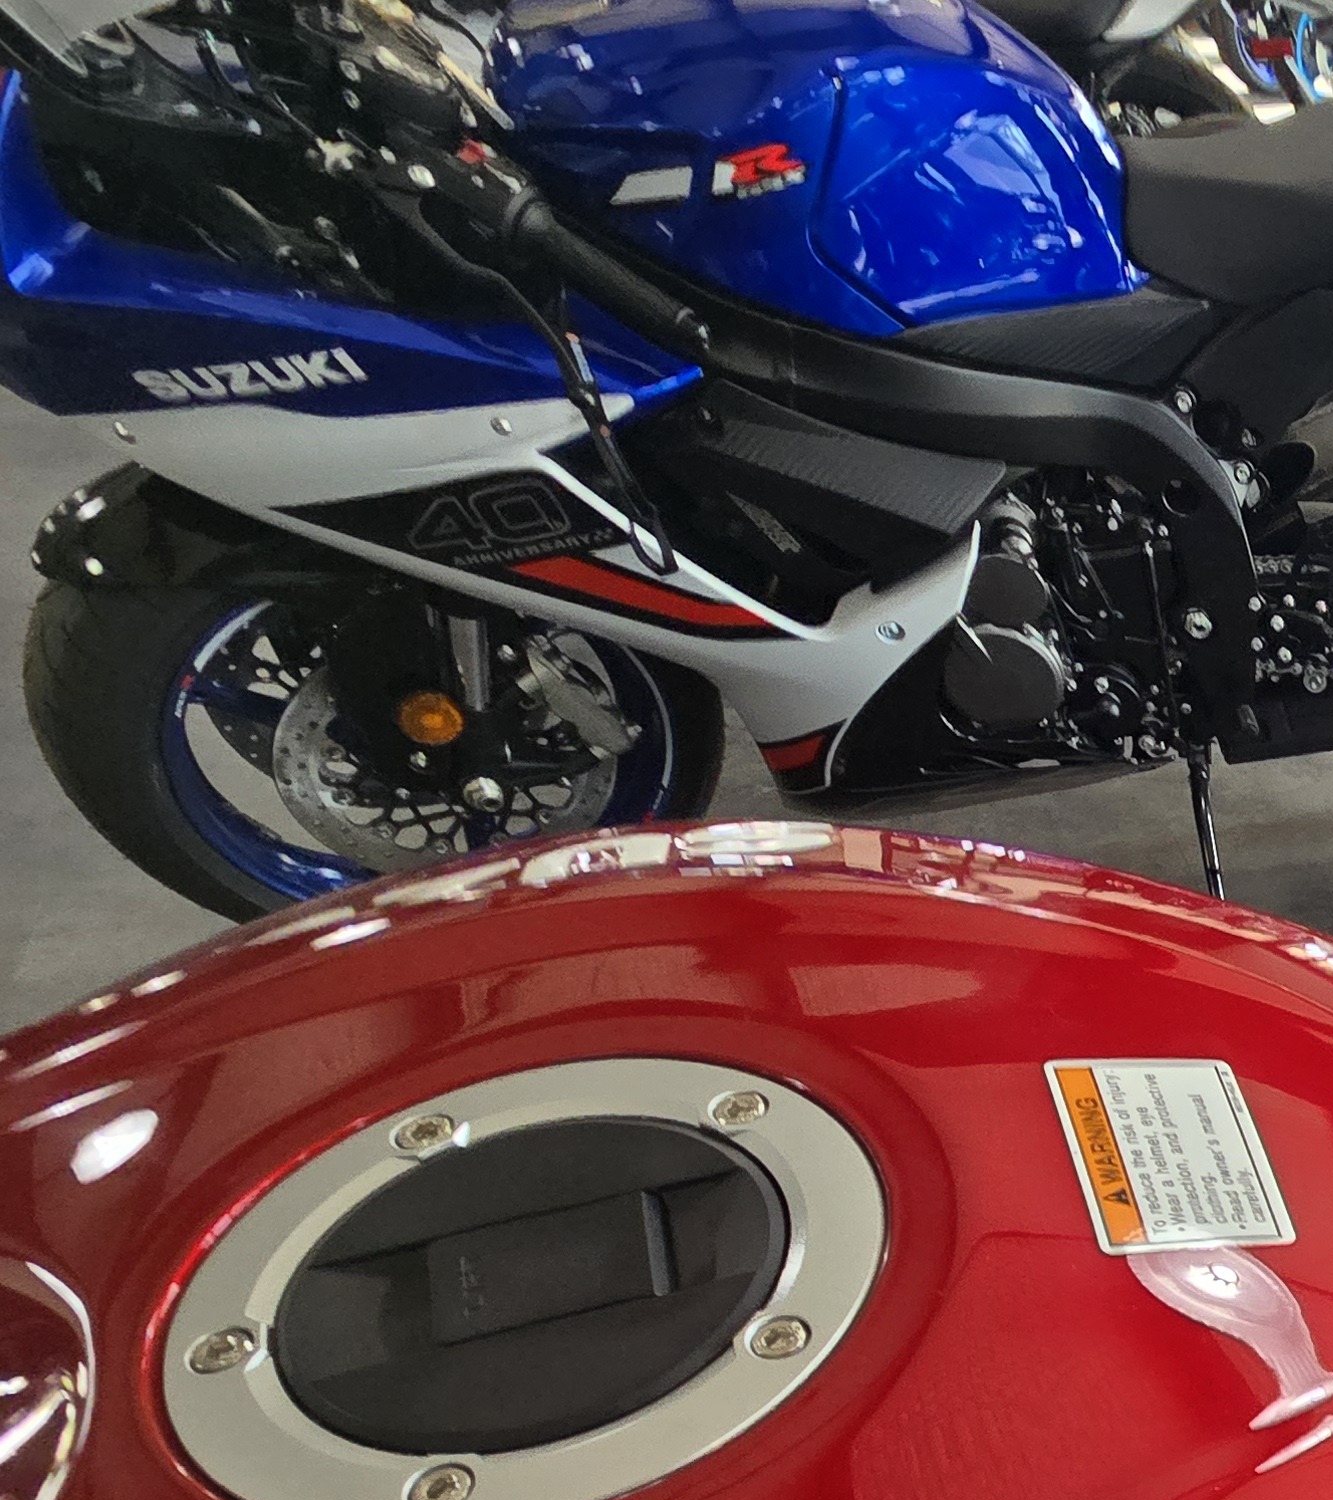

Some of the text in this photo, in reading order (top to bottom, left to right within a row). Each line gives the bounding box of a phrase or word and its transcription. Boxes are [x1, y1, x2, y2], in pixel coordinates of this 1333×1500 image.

[132, 347, 368, 400] SUZUKI
[453, 533, 595, 567] ANNIVERSARY
[1113, 1107, 1130, 1120] of
[1121, 1123, 1139, 1144] risk
[1136, 1106, 1153, 1127] eye
[1188, 1094, 1216, 1135] manual
[1075, 1097, 1123, 1186] WARNING
[1130, 1149, 1146, 1169] the
[1143, 1131, 1170, 1175] helmet,
[1144, 1073, 1212, 1225] protection, and protective
[1206, 1138, 1234, 1186] owner's
[1138, 1173, 1163, 1215] reduce
[1162, 1179, 1175, 1188] a
[1200, 1172, 1228, 1224] clothing.
[1237, 1167, 1267, 1223] carefully.
[1151, 1219, 1167, 1235] To
